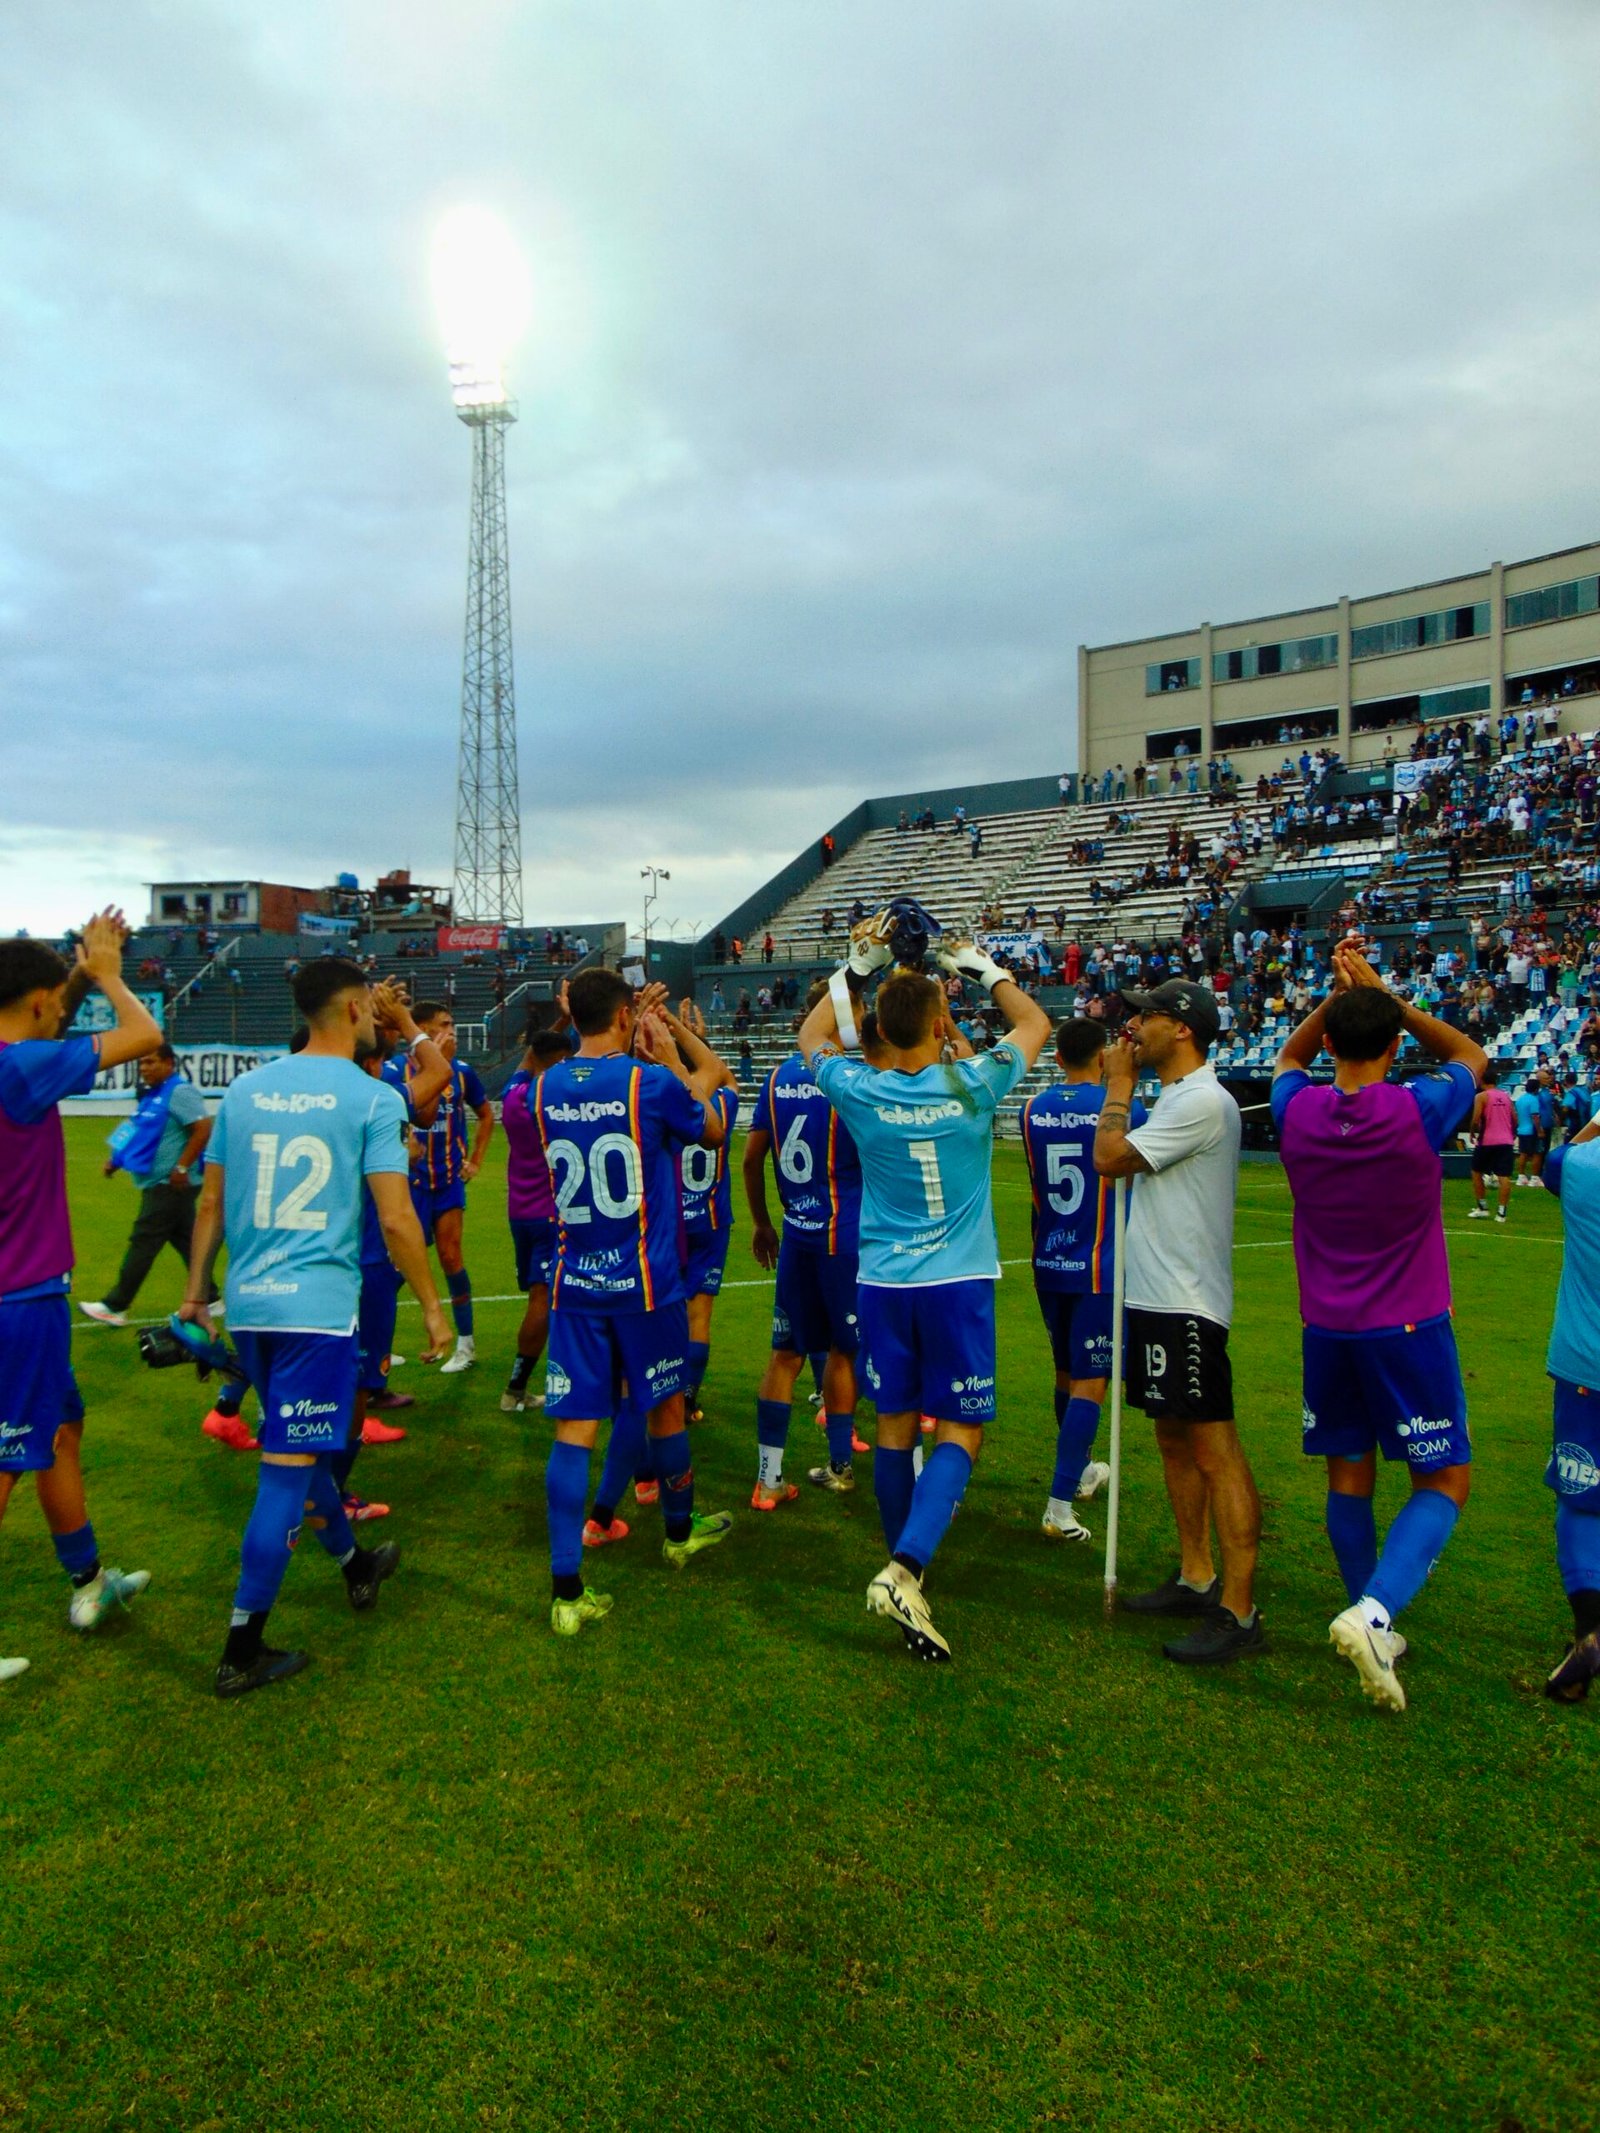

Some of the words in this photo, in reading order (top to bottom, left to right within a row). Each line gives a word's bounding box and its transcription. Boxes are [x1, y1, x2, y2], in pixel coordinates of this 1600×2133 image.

[774, 1083, 827, 1100] TeleKin
[544, 1100, 626, 1122] TeleKino
[780, 1114, 814, 1184] 6
[252, 1133, 333, 1231] 12
[545, 1132, 644, 1224] 20
[908, 1140, 946, 1220] 1
[1046, 1143, 1085, 1215] 5
[652, 1373, 680, 1393] ROMA
[295, 1399, 339, 1418] Nonna
[287, 1421, 332, 1438] ROMA
[1411, 1416, 1453, 1434] Nonna
[1408, 1438, 1452, 1456] ROMA
